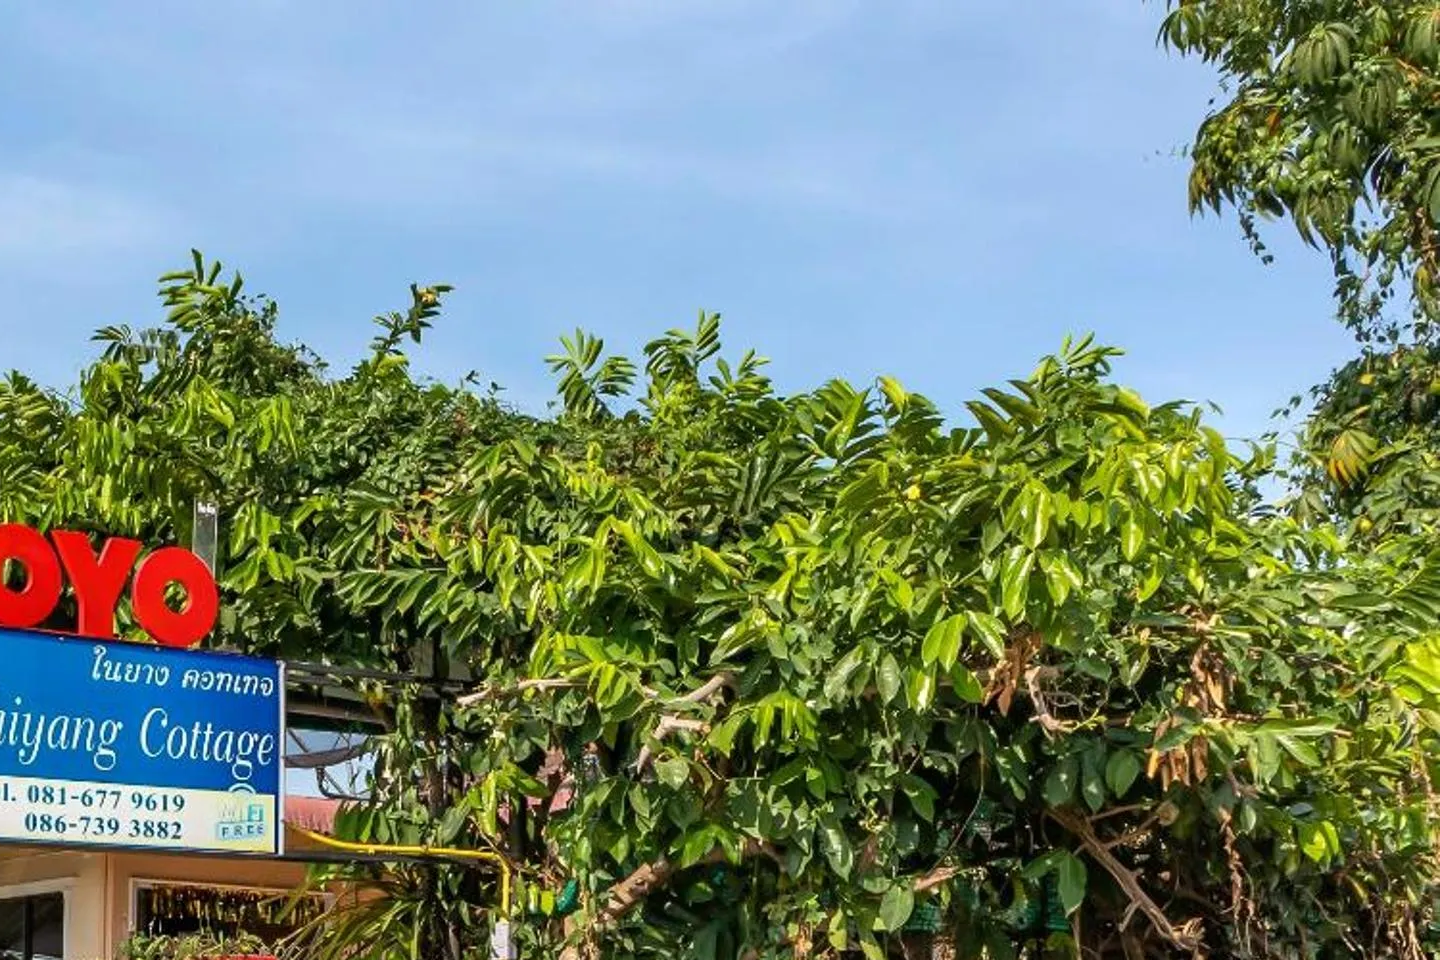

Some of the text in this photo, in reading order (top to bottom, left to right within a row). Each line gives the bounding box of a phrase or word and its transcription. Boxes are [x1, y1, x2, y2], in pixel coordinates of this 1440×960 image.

[92, 645, 170, 686] ในยาง
[139, 708, 274, 780] Cottage
[27, 784, 122, 811] 081-677
[131, 790, 186, 813] 9619
[24, 812, 182, 841] 086-739 3882
[221, 823, 264, 839] FREE
